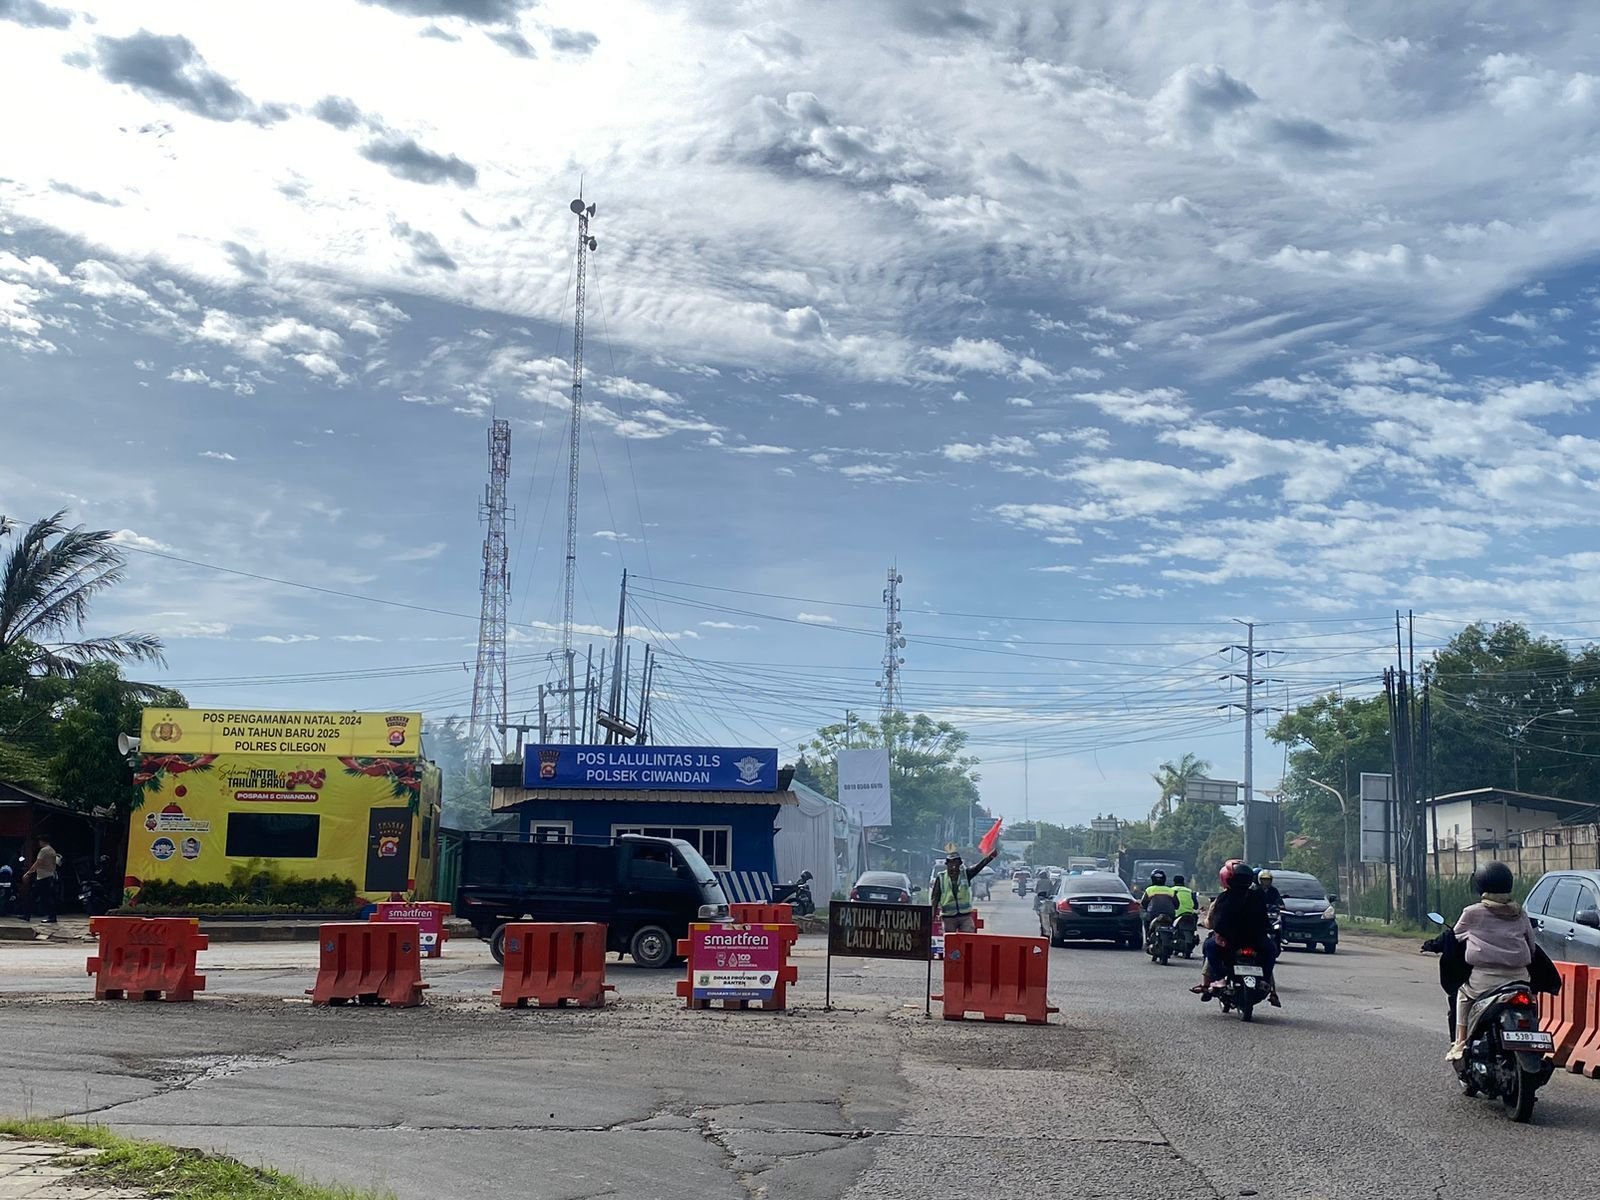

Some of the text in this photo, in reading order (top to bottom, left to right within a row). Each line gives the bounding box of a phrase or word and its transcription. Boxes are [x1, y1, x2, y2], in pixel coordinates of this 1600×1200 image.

[203, 713, 362, 726] POS PENGAMANAN NATAL 2024
[222, 727, 340, 739] DAN TAHUN BARU 2025
[235, 741, 326, 753] POLRES CILEGON
[576, 752, 606, 765] POS
[609, 753, 693, 767] LALULINTAS
[696, 754, 721, 768] JLS
[250, 769, 277, 779] NATAL
[286, 768, 326, 789] 2025
[586, 769, 710, 783] POLSEK CIWANDAN
[228, 777, 286, 789] TAHUN BARU
[237, 792, 269, 800] POSPAM
[276, 793, 317, 801] CIWANDAN
[389, 909, 432, 917] smartfren
[839, 907, 921, 931] PATUHI ATURAN
[704, 932, 769, 946] smartfren
[846, 929, 912, 951] LALU LINTAS
